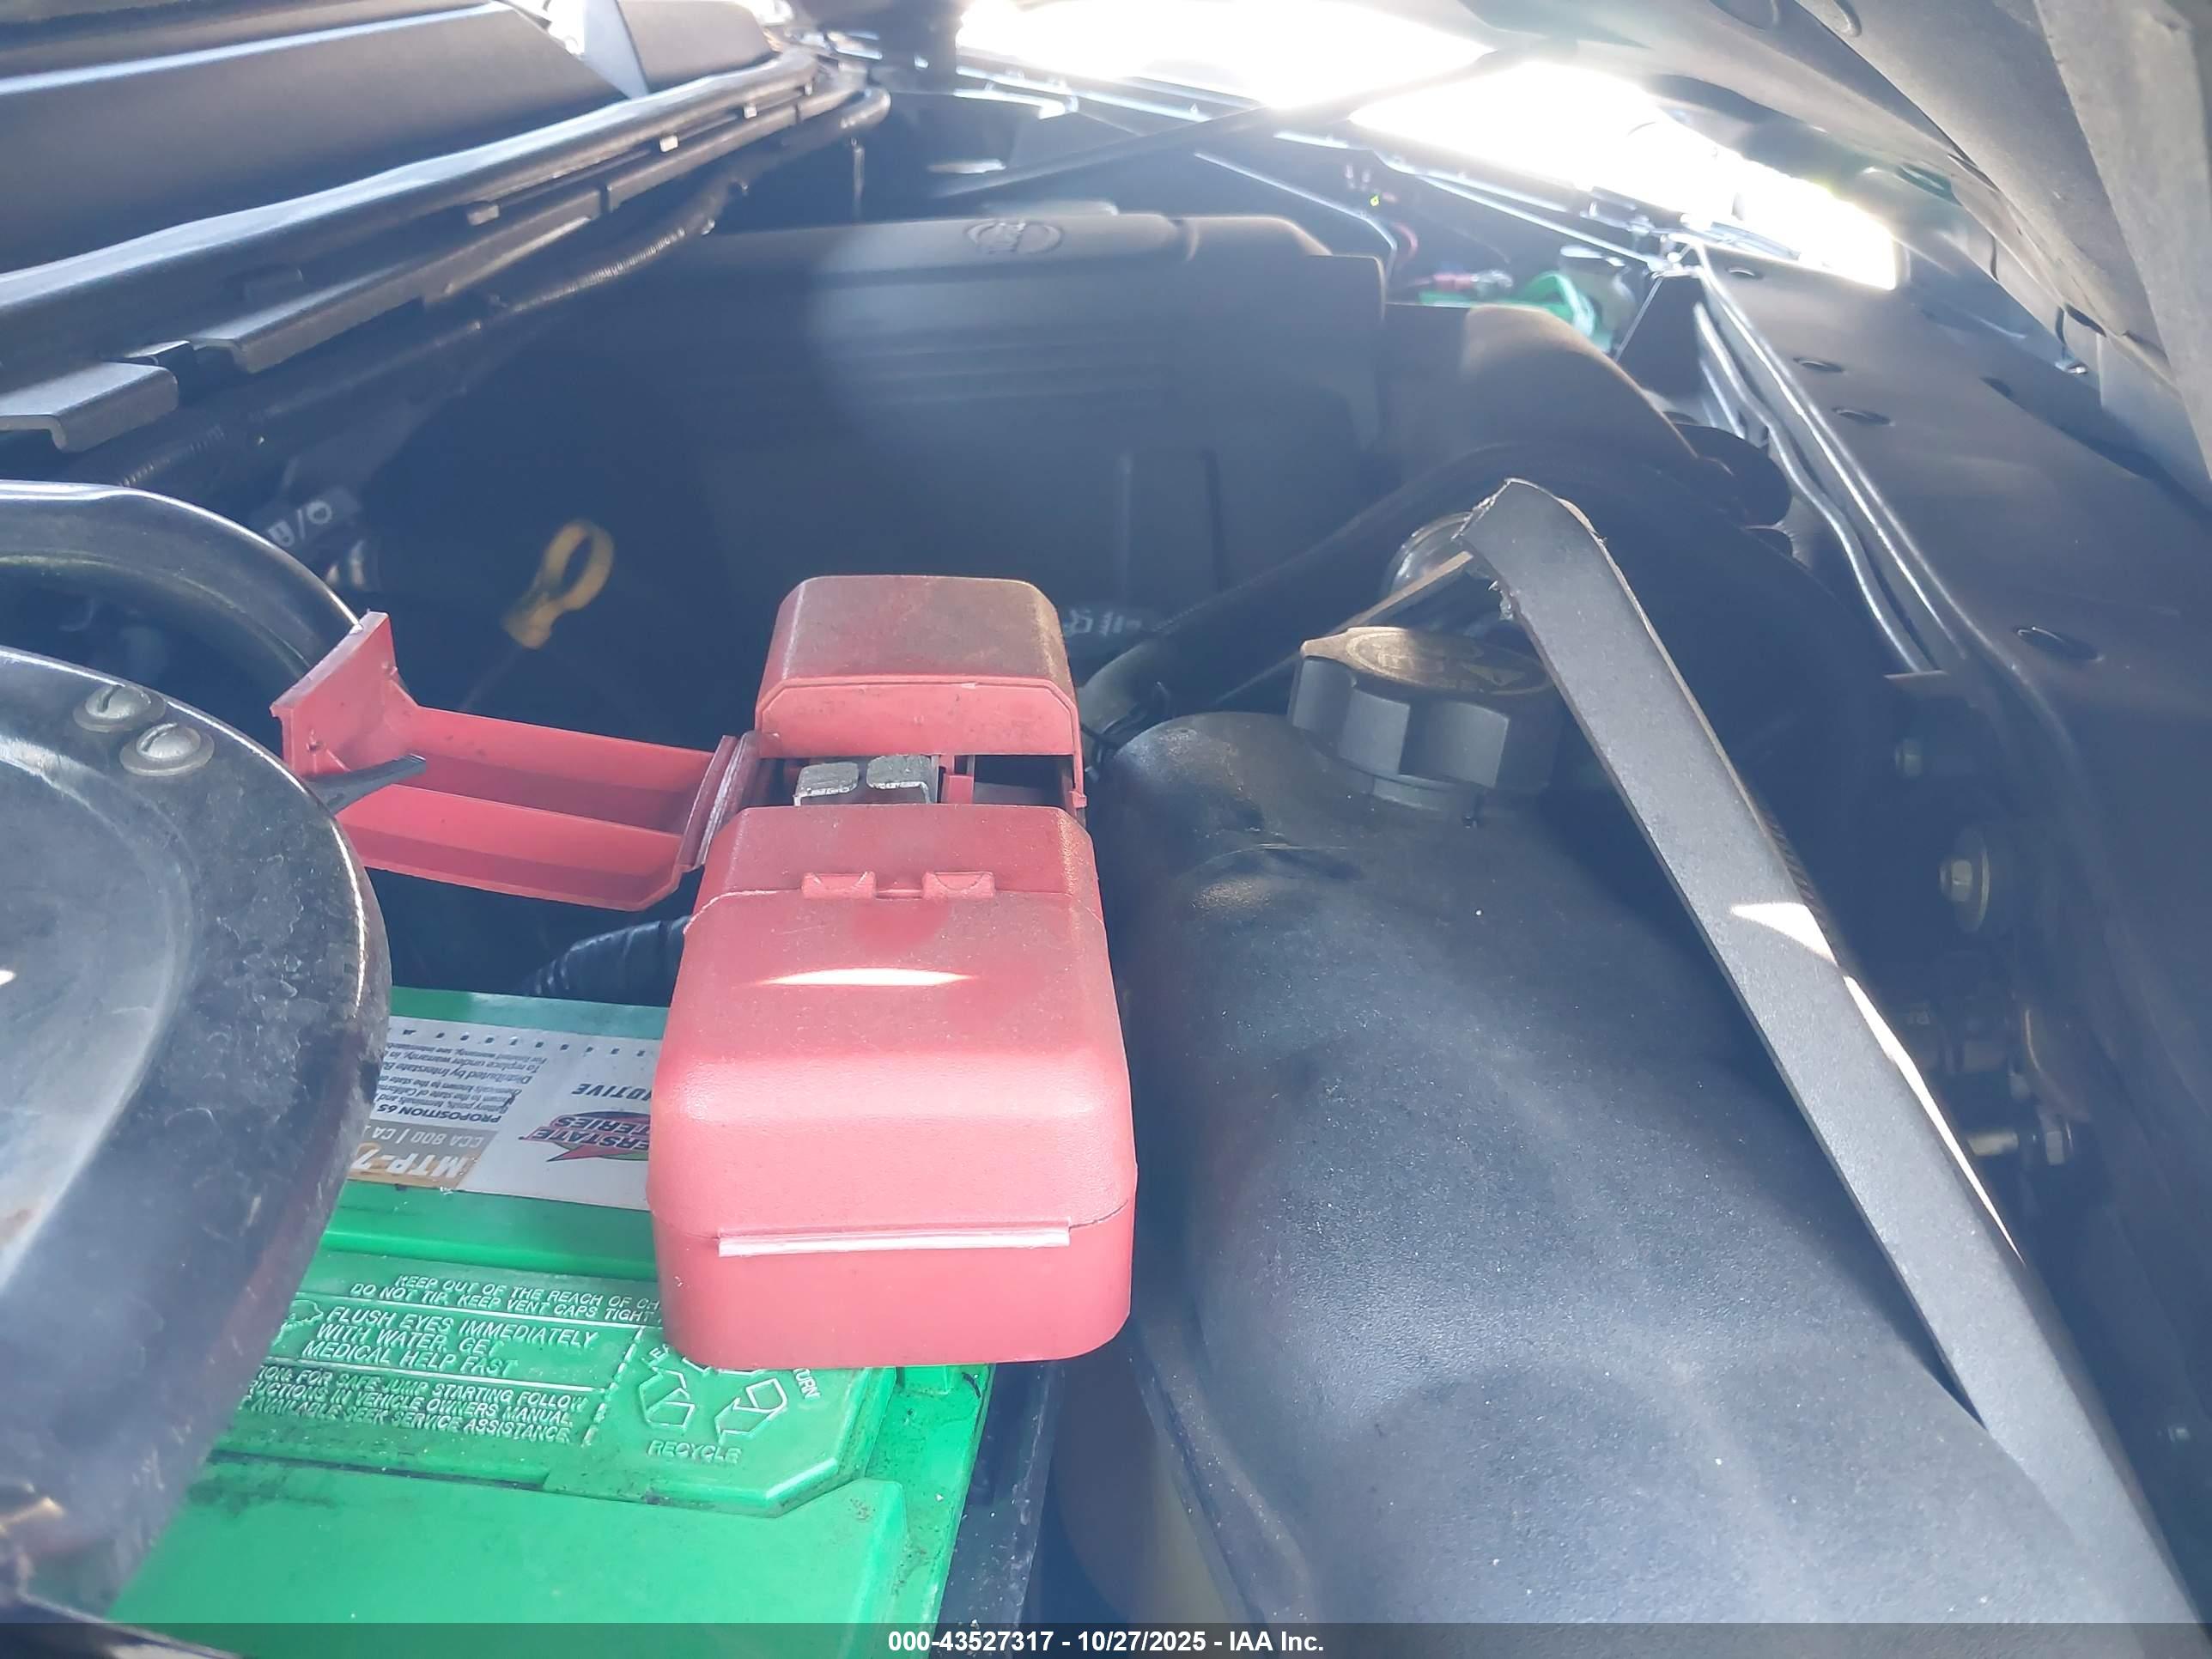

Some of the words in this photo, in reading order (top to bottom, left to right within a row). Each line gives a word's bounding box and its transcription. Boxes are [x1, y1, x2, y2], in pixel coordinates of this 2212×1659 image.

[396, 1063, 450, 1077] Interstate
[450, 1068, 466, 1079] by
[377, 1104, 398, 1113] 65
[398, 1107, 501, 1123] PROPOSITION
[372, 1127, 396, 1139] CA
[410, 1131, 447, 1145] 800
[449, 1135, 484, 1148] CCA
[350, 1282, 377, 1297] DO
[379, 1286, 418, 1302] NOT
[457, 1294, 501, 1310] KEEP
[507, 1299, 550, 1314] VENT
[554, 1304, 599, 1318] CAPS
[395, 1274, 439, 1290] KEEP
[442, 1279, 480, 1293] OUT
[482, 1284, 507, 1297] OF
[511, 1286, 545, 1300] THE
[547, 1290, 604, 1306] REACH
[608, 1296, 633, 1308] OF
[636, 1297, 661, 1310] CH
[326, 1306, 397, 1331] FLUSH
[399, 1313, 454, 1335] EYES
[459, 1319, 599, 1349] IMMEDIATELY
[316, 1323, 369, 1345] WITH
[459, 1337, 505, 1357] GET
[301, 1340, 392, 1364] MEDICAL
[399, 1350, 457, 1372] HELP
[460, 1355, 519, 1378] FAST
[295, 1369, 333, 1387] FOR
[337, 1373, 382, 1393] SAFE
[382, 1378, 429, 1397] JUMP
[431, 1382, 514, 1404] STARTING
[517, 1391, 589, 1413] FOLLOW
[330, 1389, 352, 1406] IN
[356, 1391, 425, 1413] VEHICLE
[426, 1396, 499, 1419] OWNERS
[343, 1407, 389, 1425] SEEK
[391, 1410, 464, 1432] SERVICE
[647, 1440, 743, 1464] RECYCLE
